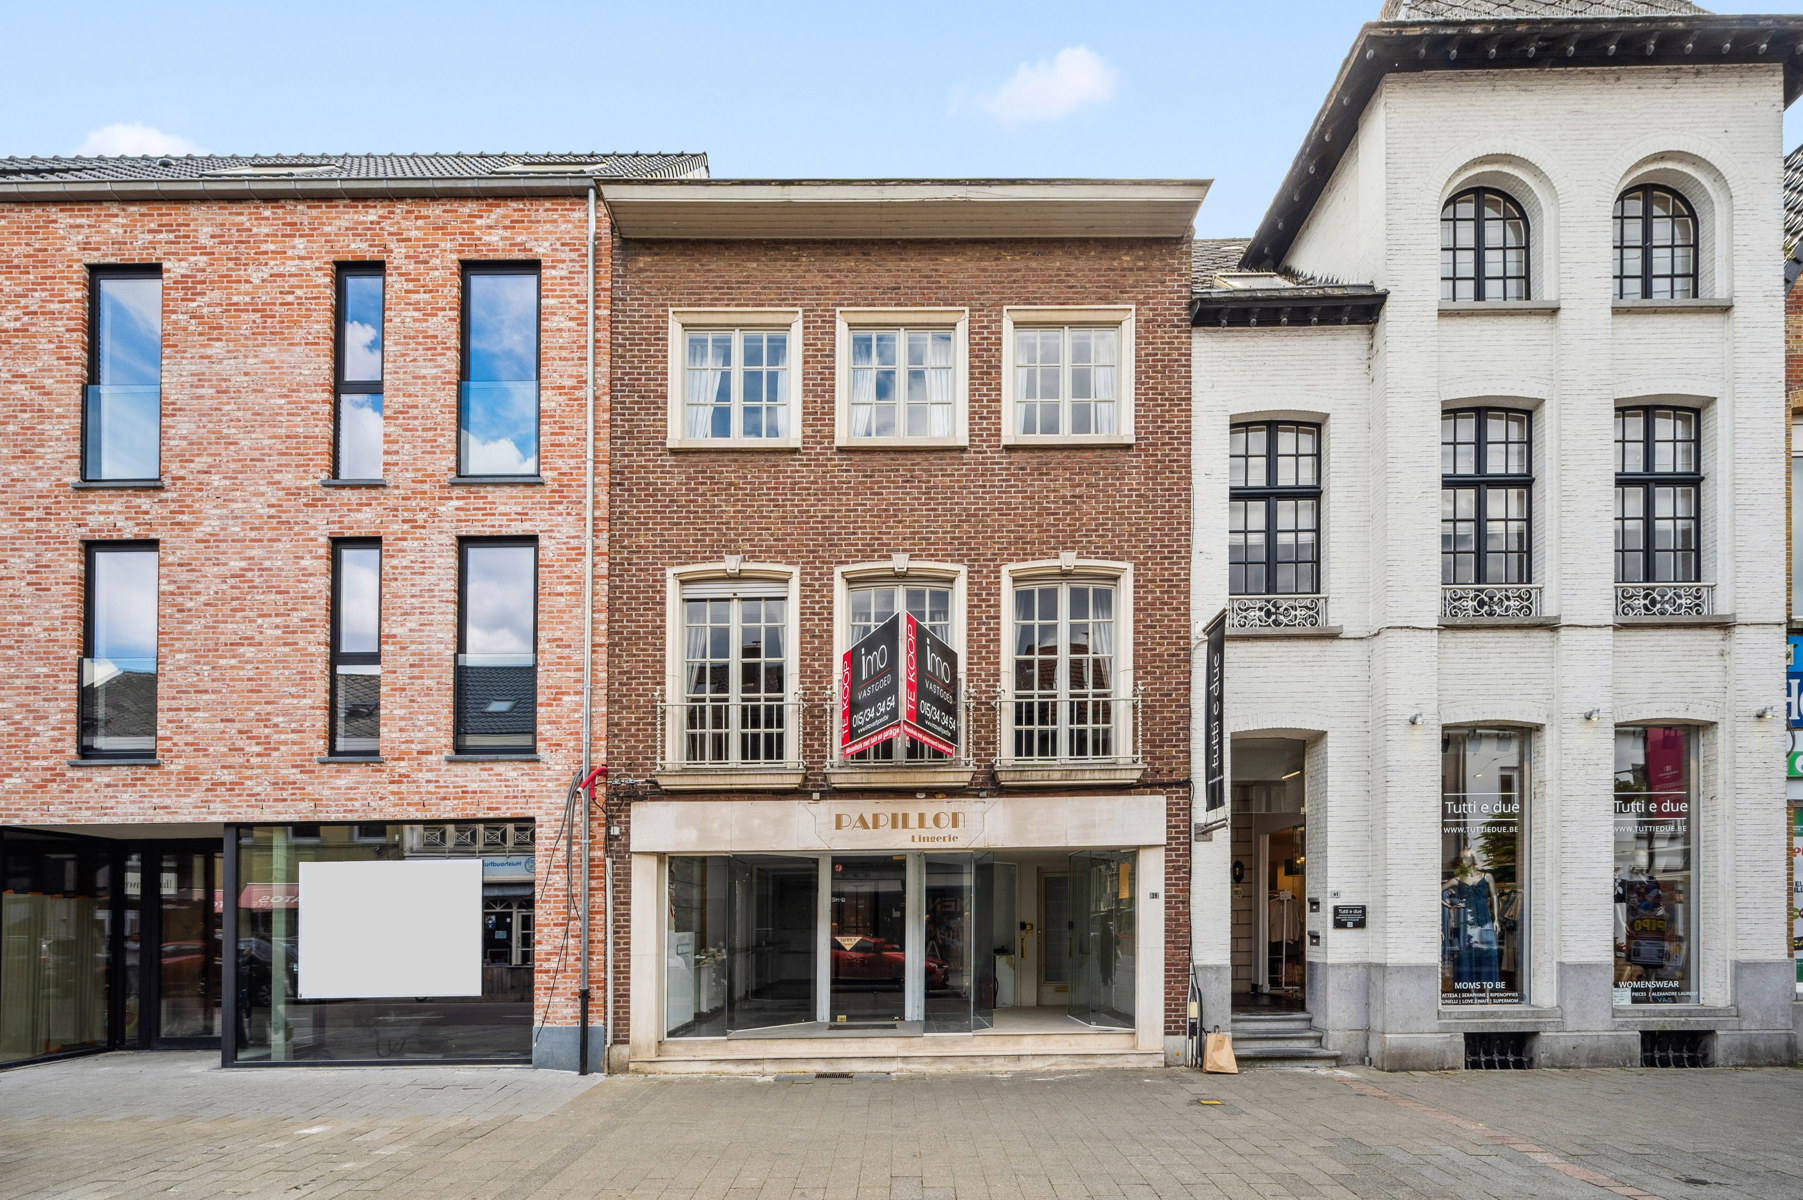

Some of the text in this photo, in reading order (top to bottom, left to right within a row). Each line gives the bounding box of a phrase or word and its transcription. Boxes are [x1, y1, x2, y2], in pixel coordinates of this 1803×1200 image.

[861, 644, 888, 681] imo
[908, 624, 916, 710] TE KOOP
[926, 637, 951, 684] imo
[1210, 653, 1220, 696] due
[842, 660, 850, 710] KOOP
[858, 674, 892, 700] VASTGOED
[924, 679, 954, 704] VASTGOED
[852, 694, 895, 728] 015/34 34 54
[920, 700, 956, 731] 015/34 34 54
[1213, 701, 1220, 715] e
[1212, 721, 1220, 769] tutti
[835, 811, 965, 830] PAPILLON
[1445, 801, 1520, 814] Tutti e due
[1614, 800, 1688, 813] Tutti e due
[911, 834, 958, 843] Lingerie
[1495, 981, 1506, 989] BE
